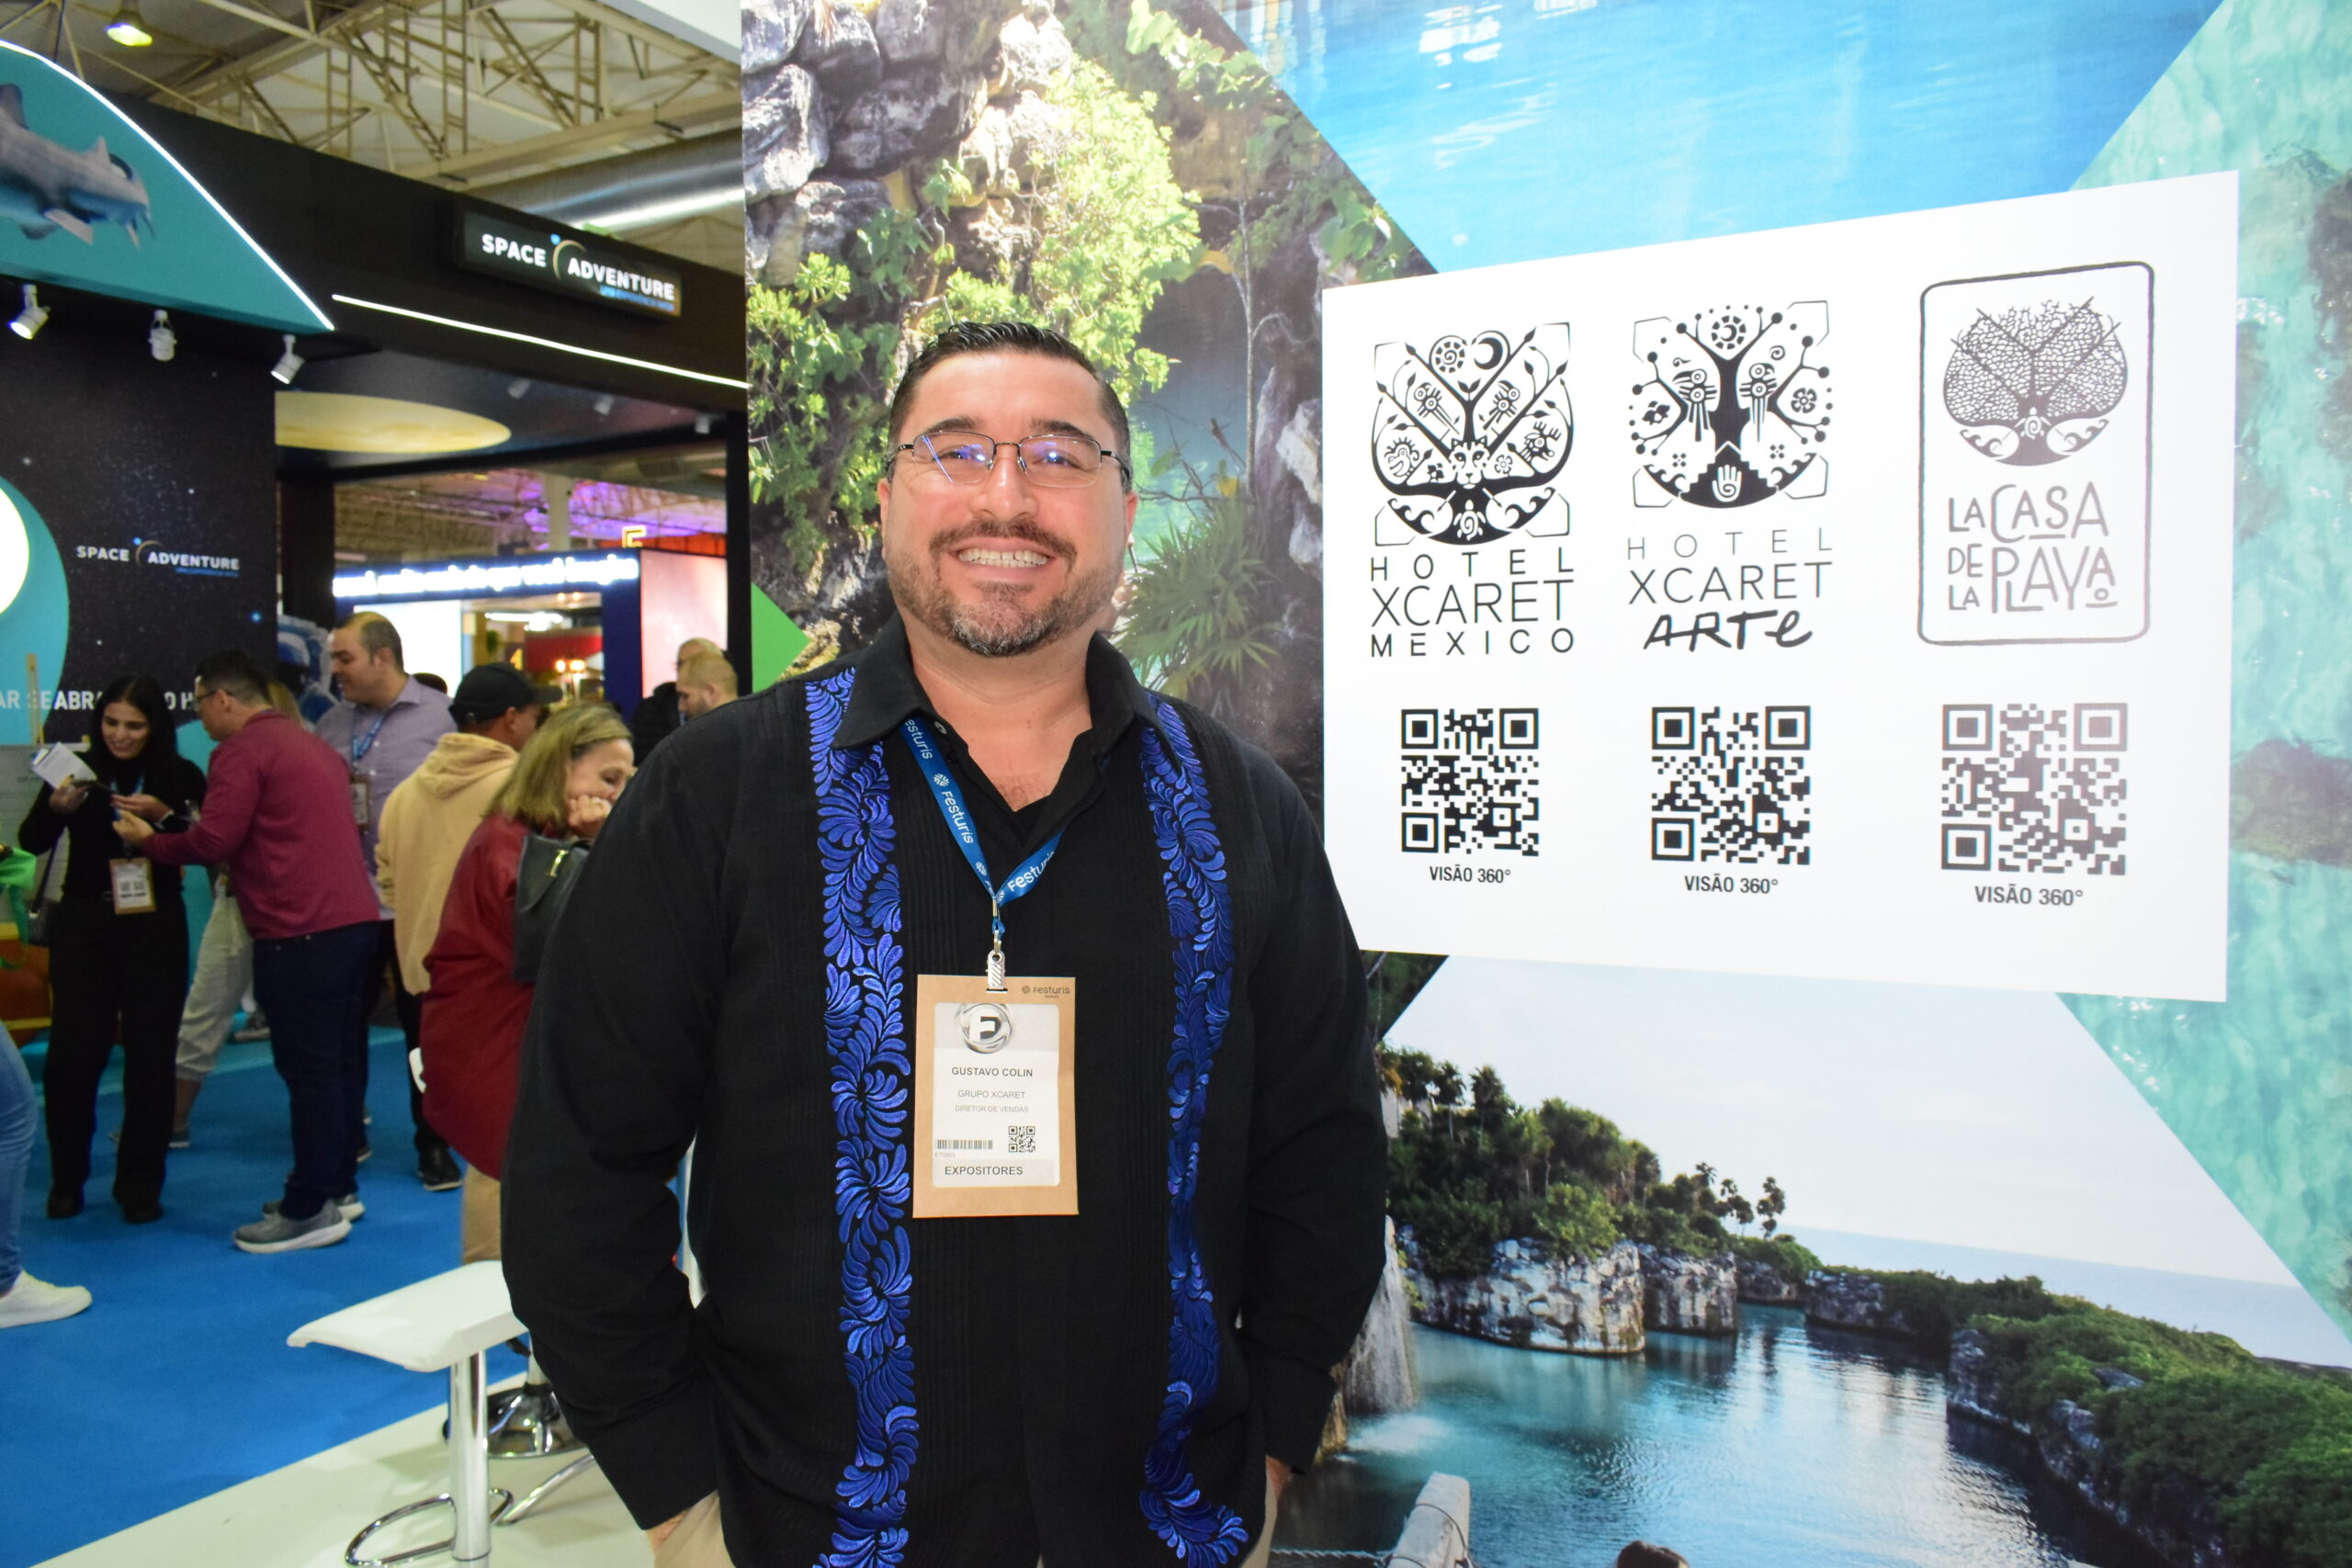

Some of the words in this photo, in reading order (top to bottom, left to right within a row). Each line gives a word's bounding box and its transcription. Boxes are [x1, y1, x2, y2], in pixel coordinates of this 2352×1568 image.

[481, 233, 547, 267] SPACE
[567, 257, 675, 301] ADVENTURE
[1949, 497, 1985, 533] LA
[1991, 480, 2109, 544] CASA
[1627, 527, 1833, 560] HOTEL
[76, 546, 130, 562] SPACE
[147, 551, 241, 570] ADVENTURE
[1371, 547, 1574, 581] HOTEL
[1948, 543, 1984, 578] DE
[1628, 561, 1833, 604] XCARET
[1991, 545, 2117, 614] PLAYA
[1371, 579, 1575, 626] XCARET
[1949, 584, 1981, 611] LA
[941, 790, 975, 844] Festuris
[1429, 863, 1474, 883] VISÃO
[1476, 868, 1511, 884] 360°
[1684, 873, 1735, 894] VISÃO
[1739, 877, 1780, 895] 360°
[1974, 883, 2033, 906] VISÃO
[2038, 888, 2084, 907] 360°
[1033, 985, 1070, 995] Festuris
[951, 1066, 1000, 1077] GUSTAVO
[1001, 1067, 1034, 1077] COLIN
[957, 1089, 989, 1099] GRUPO
[990, 1090, 1026, 1100] XCARET
[955, 1105, 987, 1113] DIRETOR
[988, 1105, 999, 1113] DE
[1000, 1105, 1030, 1113] VENDAS
[944, 1165, 1024, 1177] EXPOSITORES
